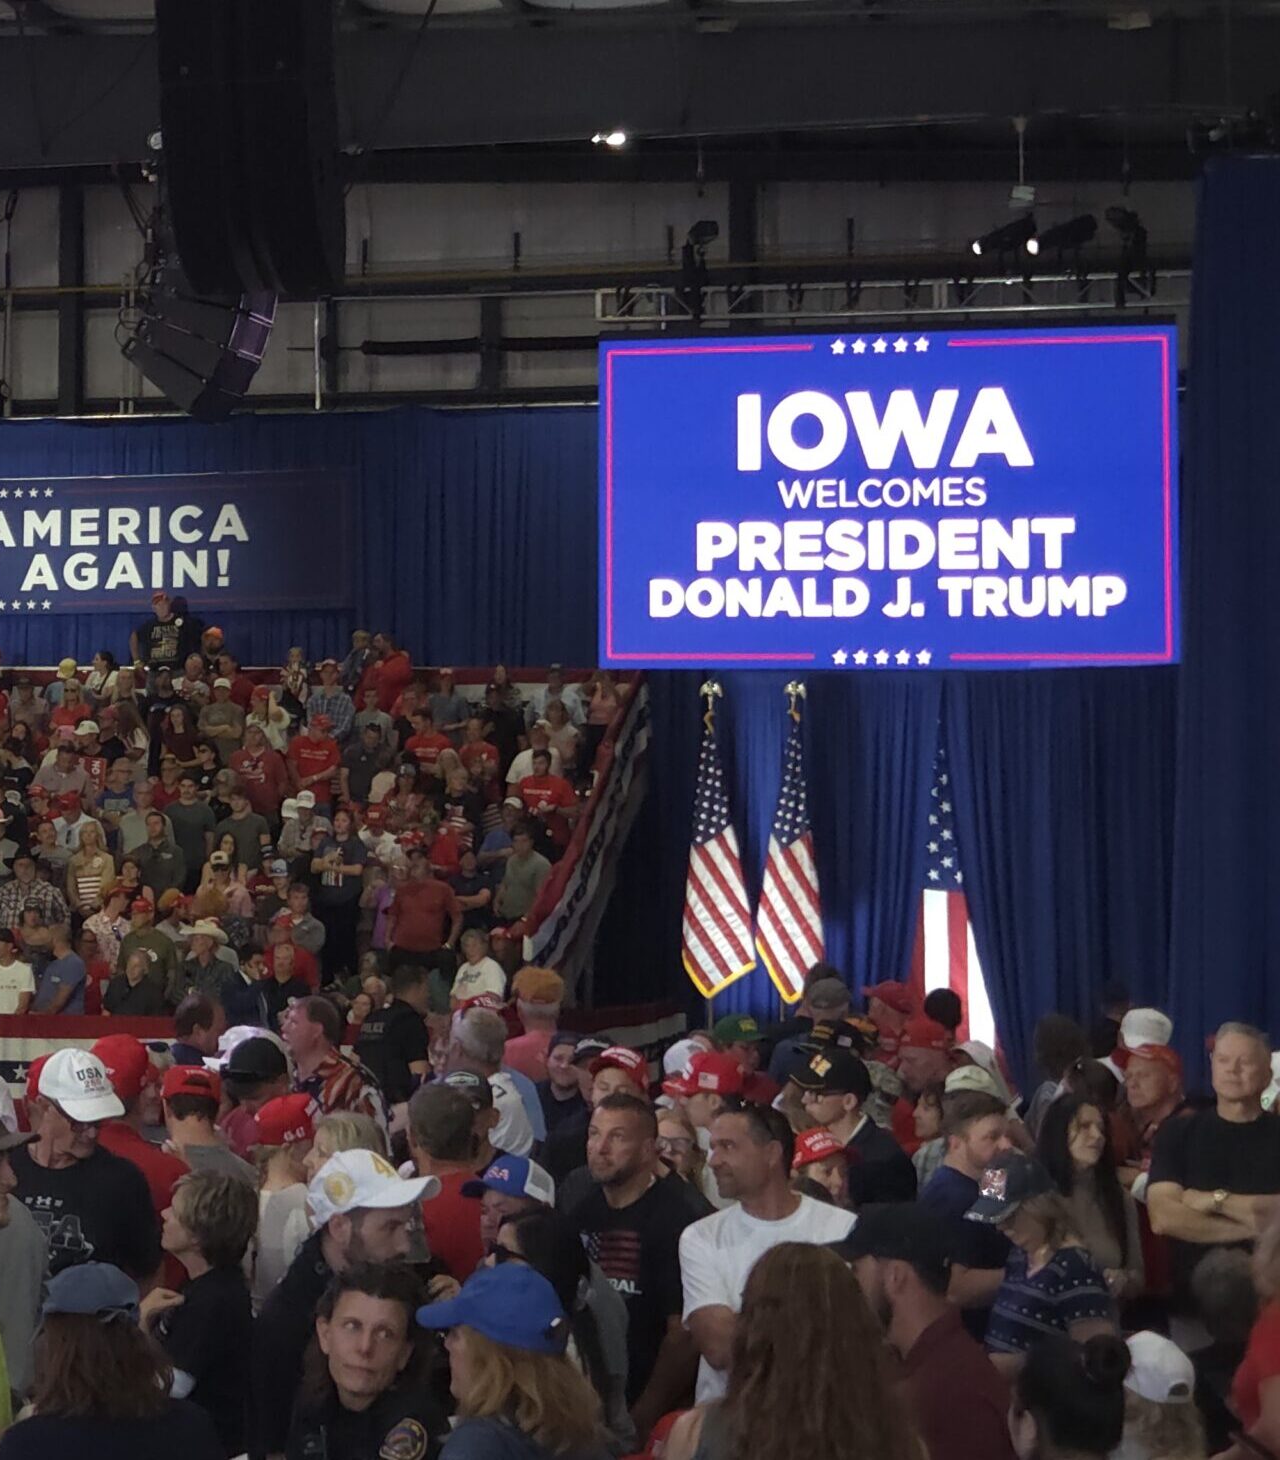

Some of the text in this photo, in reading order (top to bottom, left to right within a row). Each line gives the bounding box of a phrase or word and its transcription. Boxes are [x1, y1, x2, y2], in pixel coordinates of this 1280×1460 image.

[737, 386, 1035, 471] IOWA
[777, 476, 987, 509] WELCOMES
[696, 517, 1075, 572] PRESIDENT
[20, 548, 230, 591] AGAIN!
[649, 575, 1128, 618] DONALD J. TRUMP
[76, 1066, 103, 1081] USA
